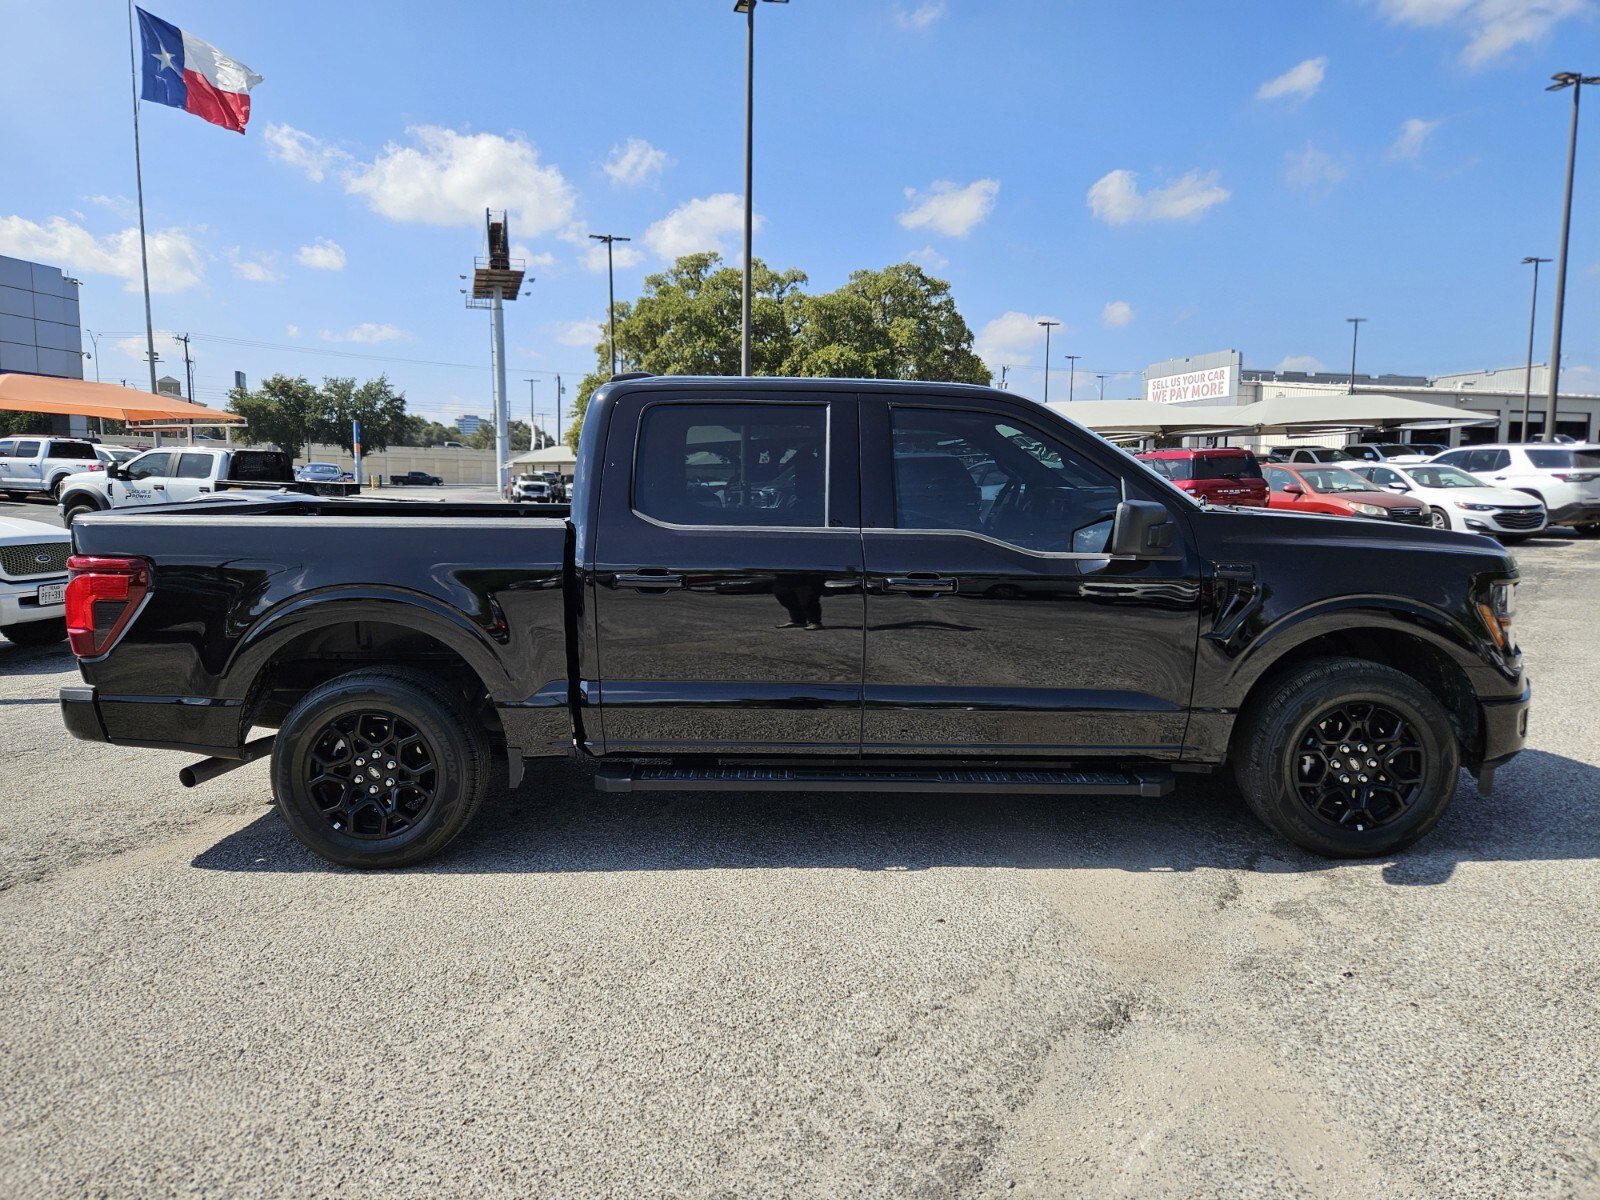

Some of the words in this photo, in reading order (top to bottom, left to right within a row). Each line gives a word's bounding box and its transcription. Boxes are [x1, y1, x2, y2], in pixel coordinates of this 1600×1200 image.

[1152, 379, 1169, 390] SELL
[1170, 377, 1181, 387] US
[1182, 374, 1206, 385] YOUR
[1207, 370, 1225, 381] CAR
[1152, 389, 1167, 403] WE
[1170, 386, 1188, 400] PAY
[1191, 381, 1224, 398] MORE
